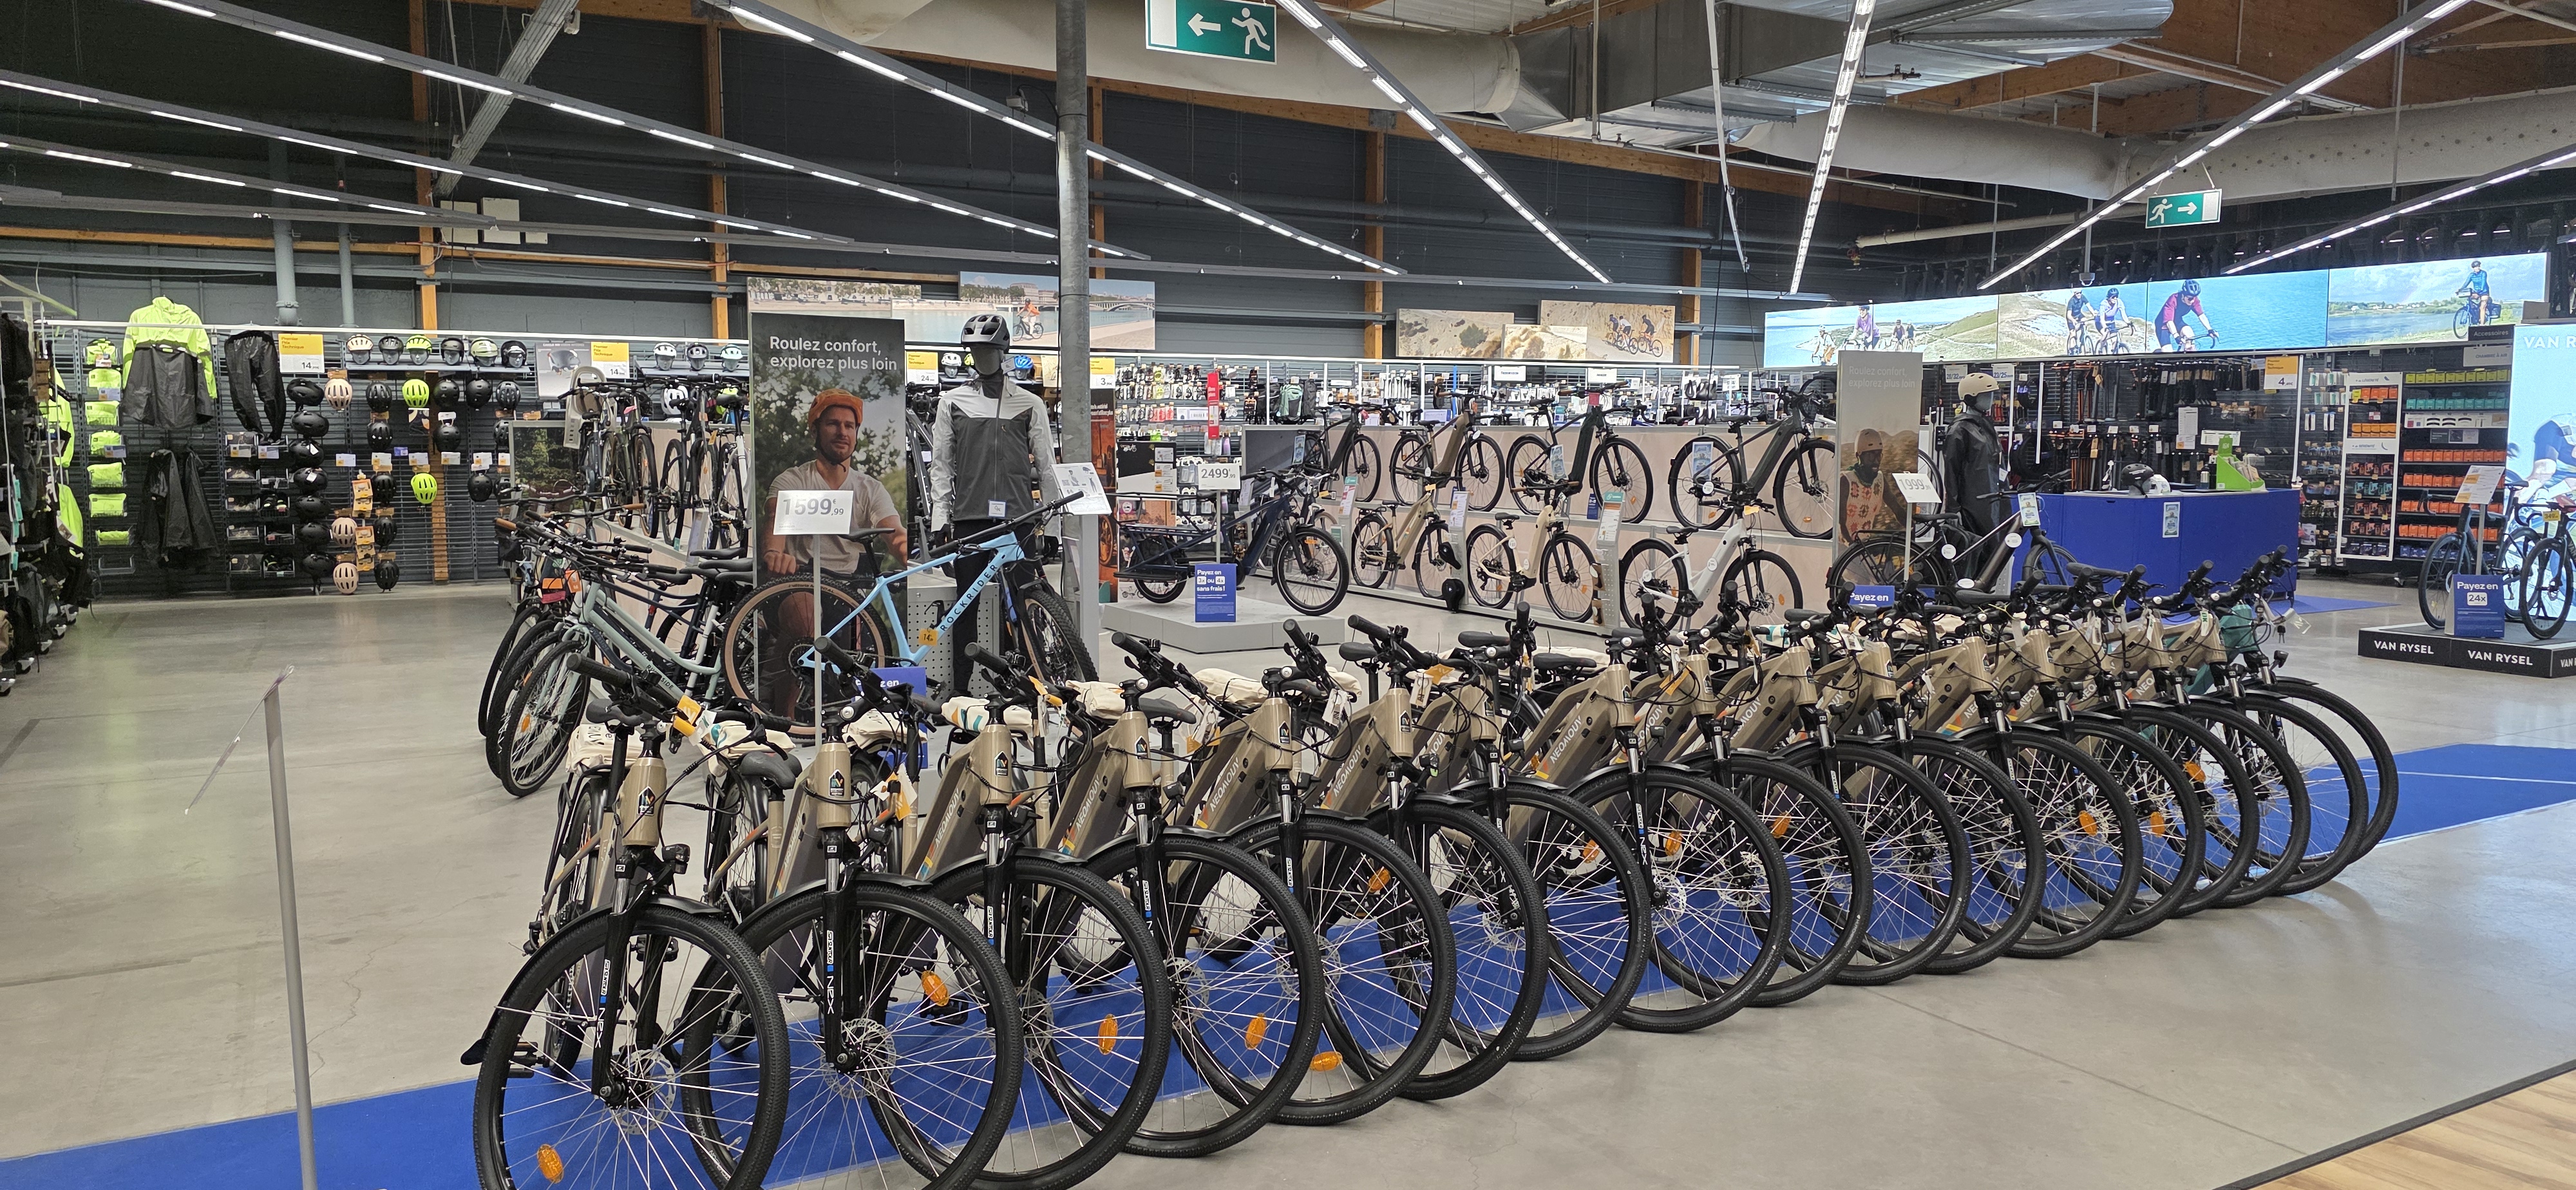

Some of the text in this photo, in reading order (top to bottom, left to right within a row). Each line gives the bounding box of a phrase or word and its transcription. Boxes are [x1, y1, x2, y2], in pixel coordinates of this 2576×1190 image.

[770, 336, 881, 355] Roulez confort,
[2524, 336, 2559, 348] VAN
[770, 355, 897, 372] explorez plus loin
[1849, 366, 1908, 377] Roulez confort,
[1849, 378, 1915, 389] explorez plus loin
[2457, 581, 2486, 590] Payez
[940, 564, 998, 631] ROCKRIDER
[2374, 640, 2434, 654] VAN RYSEL
[2467, 650, 2533, 666] VAN RYSEL
[2560, 658, 2573, 668] VAN
[1549, 715, 1582, 764] NEOMOUV
[1333, 744, 1361, 797] NEOMOUV
[1209, 757, 1239, 812] NEOMOUV
[1075, 774, 1100, 832] NEOMOUV
[935, 788, 959, 848] NEOMOUV
[1640, 837, 1648, 865] NEX
[595, 1007, 606, 1048] NEX
